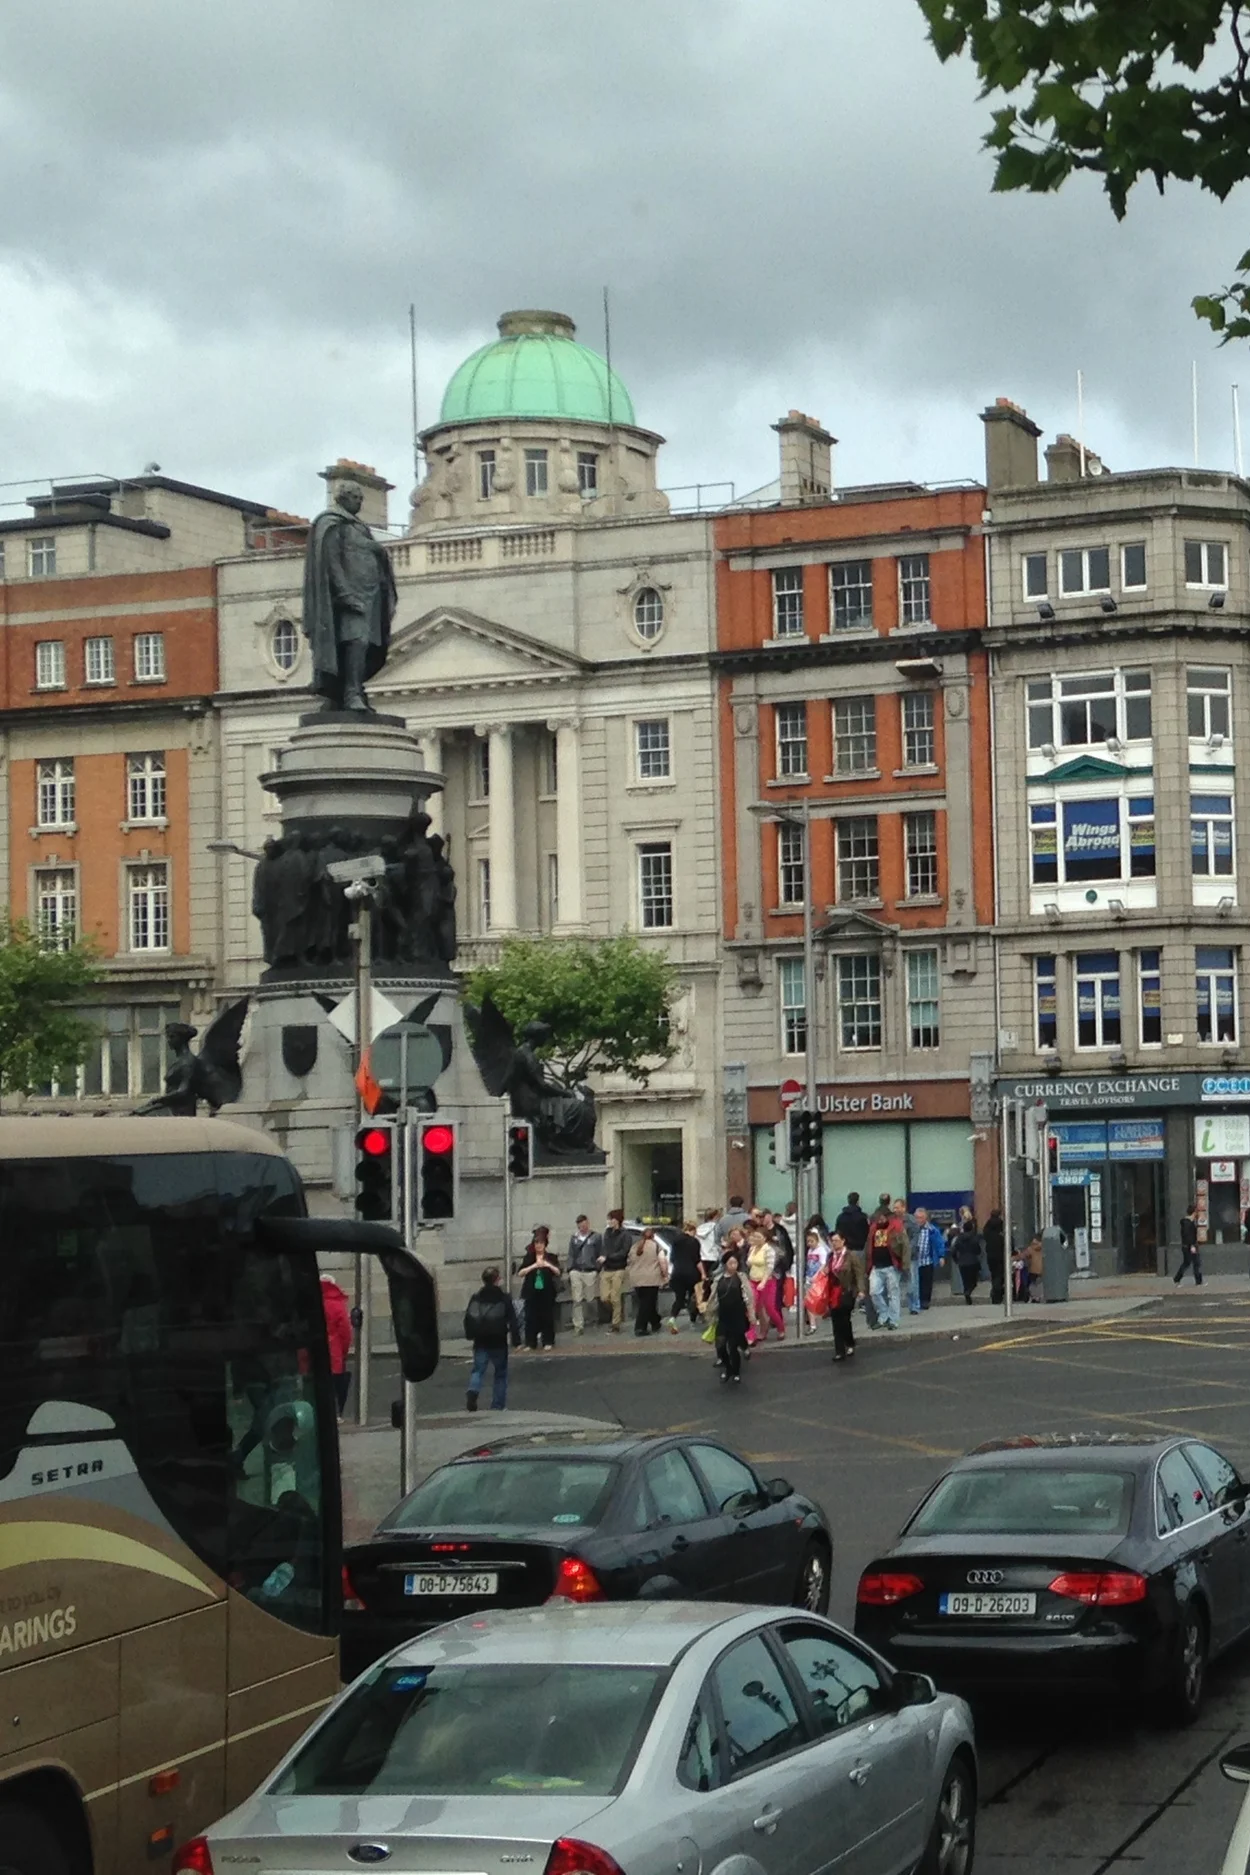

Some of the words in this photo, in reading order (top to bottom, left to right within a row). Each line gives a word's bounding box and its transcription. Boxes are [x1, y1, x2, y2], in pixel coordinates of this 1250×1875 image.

[1071, 823, 1117, 836] Wings
[1065, 834, 1120, 848] Abroad
[1014, 1081, 1094, 1098] CURRENCY
[1097, 1077, 1180, 1095] EXCHANGE
[817, 1094, 867, 1112] Ulster
[871, 1091, 913, 1110] Bank
[1060, 1096, 1091, 1106] TRAVEL
[1092, 1095, 1135, 1105] ADVISORS
[1058, 1175, 1085, 1185] SHOP
[31, 1459, 103, 1486] SETRA
[952, 1597, 1030, 1613] 09-D-26203
